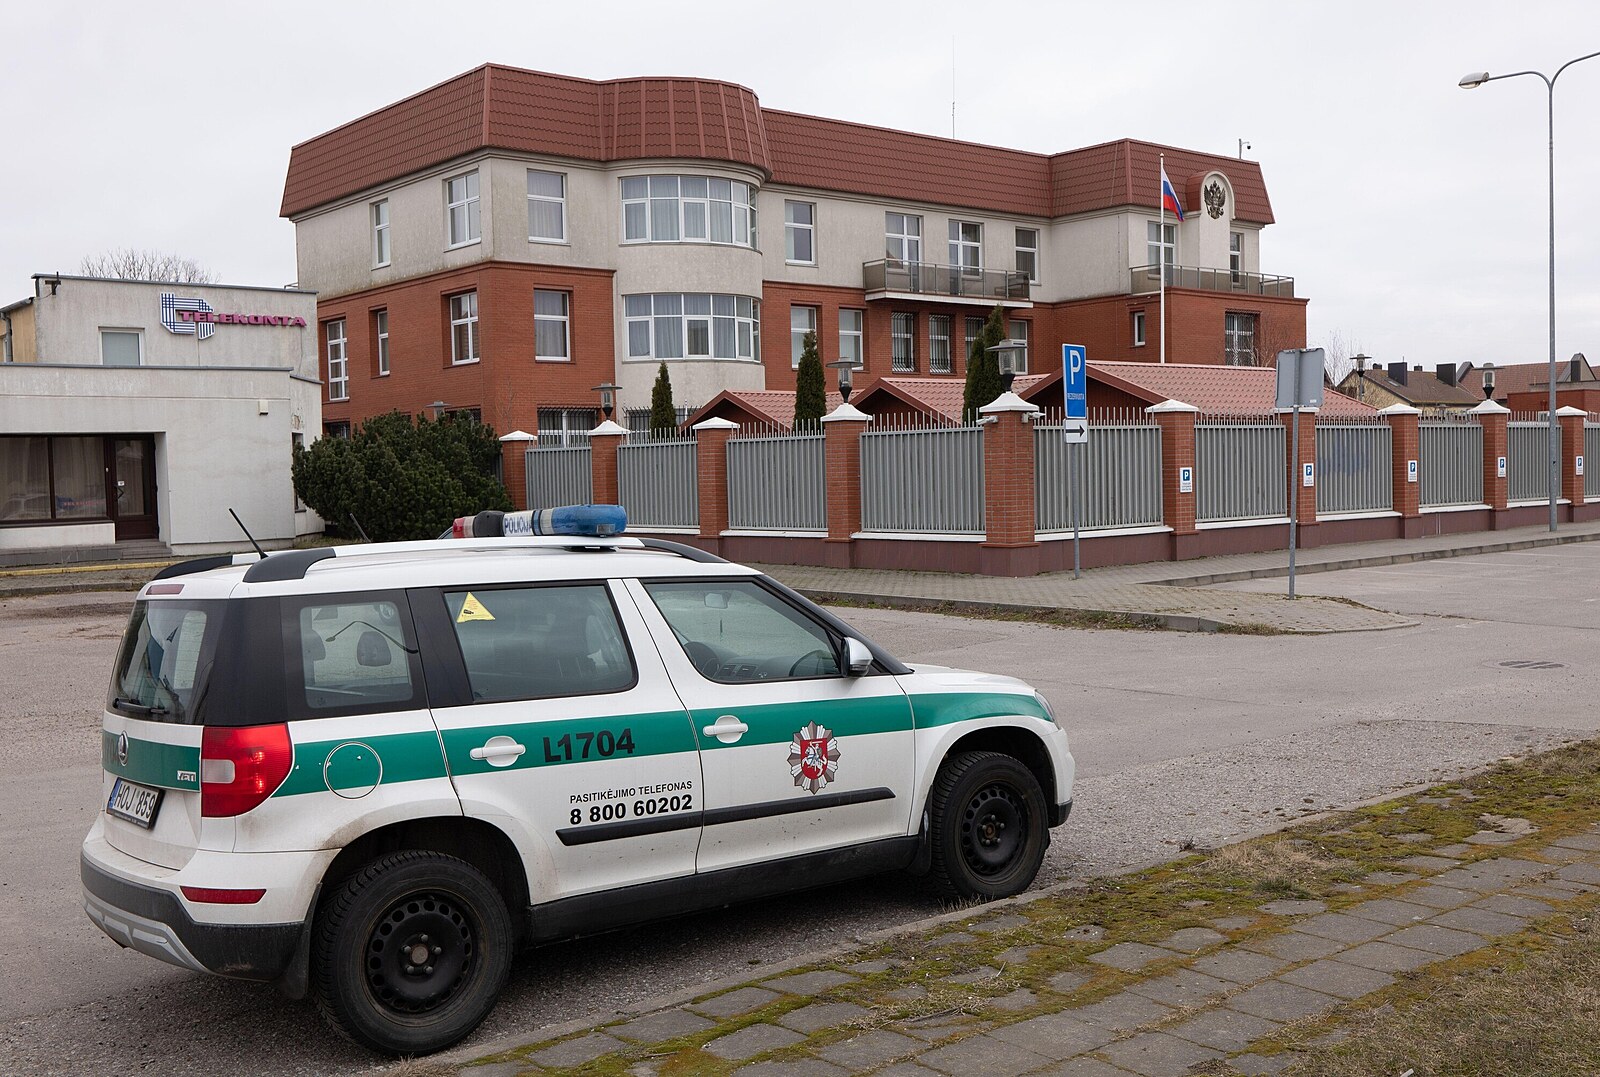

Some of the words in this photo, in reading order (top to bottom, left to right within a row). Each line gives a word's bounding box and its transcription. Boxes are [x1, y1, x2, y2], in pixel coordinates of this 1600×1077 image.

[178, 311, 307, 327] TELEKONTA
[1070, 350, 1081, 385] P
[543, 728, 635, 763] L1704
[135, 790, 156, 819] 859
[570, 788, 636, 804] PASITIKĖJIMO
[638, 780, 693, 796] TELEFONAS
[570, 808, 582, 825] 8
[589, 802, 626, 822] 800
[633, 794, 693, 816] 60202
